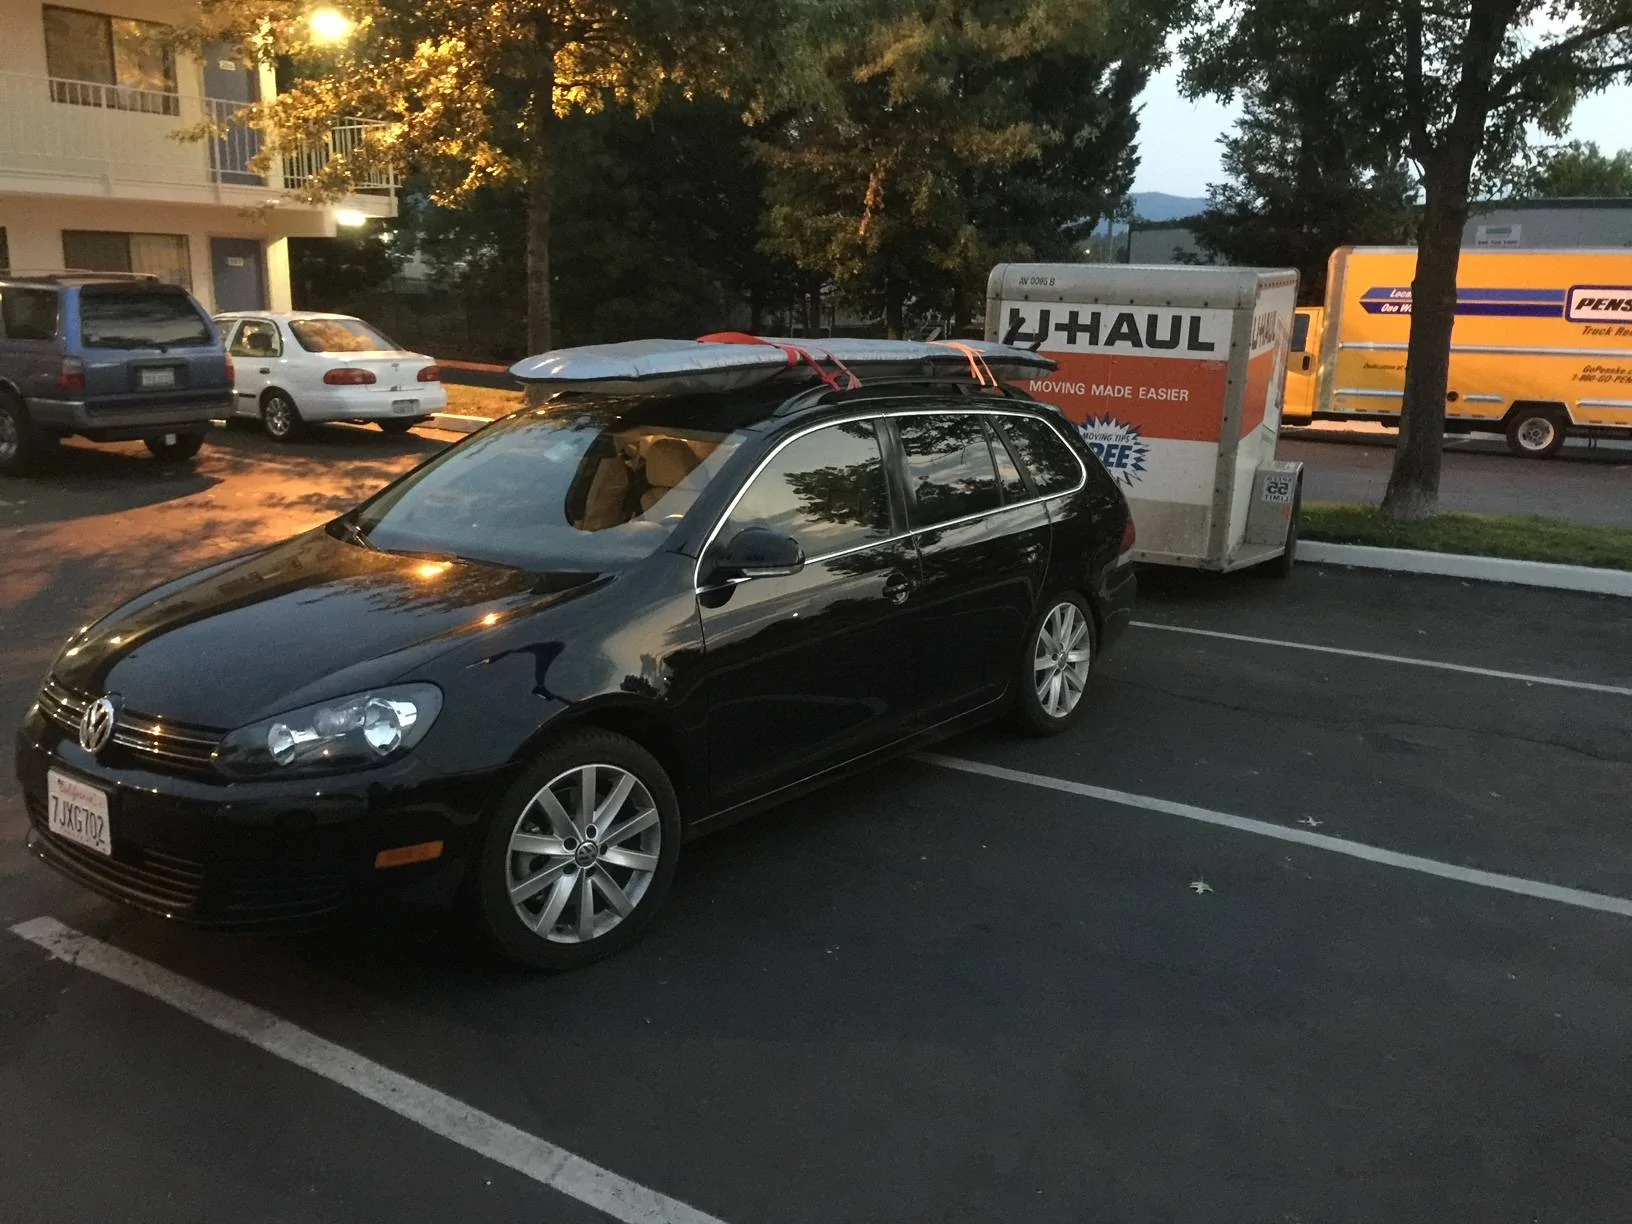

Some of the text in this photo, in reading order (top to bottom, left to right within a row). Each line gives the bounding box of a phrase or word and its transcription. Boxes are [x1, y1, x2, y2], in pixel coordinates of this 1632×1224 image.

[1381, 303, 1398, 312] One
[1575, 297, 1632, 312] PENS
[1008, 308, 1215, 352] U-HAUL
[1581, 326, 1613, 336] Truck
[1029, 380, 1189, 402] MOVING MADE EASIER
[1082, 432, 1131, 443] MOVING TIPS
[1088, 442, 1133, 468] REE
[51, 795, 105, 845] 7JXG702
